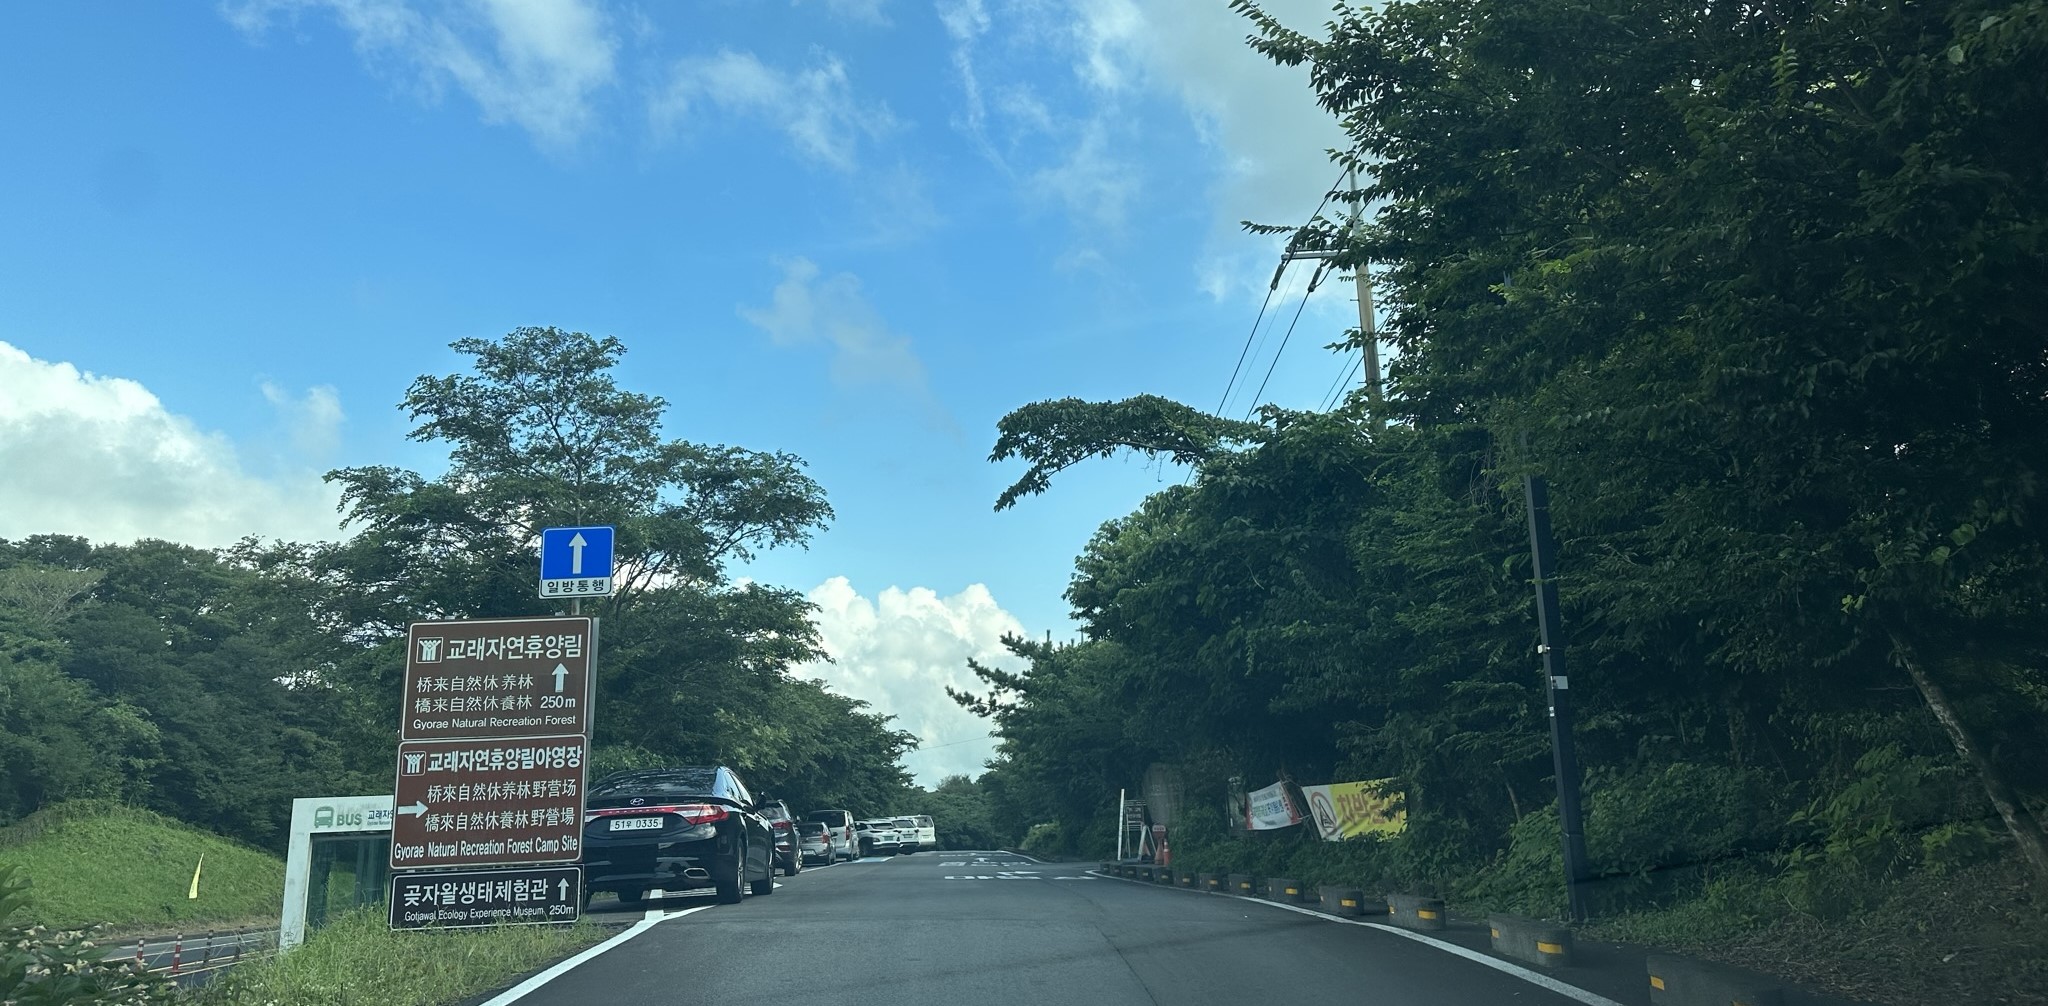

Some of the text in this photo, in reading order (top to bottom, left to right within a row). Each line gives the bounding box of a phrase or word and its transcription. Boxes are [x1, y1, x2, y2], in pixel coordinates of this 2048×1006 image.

[548, 580, 604, 593] 일방통행
[446, 634, 582, 661] 교래자연휴양림
[416, 673, 534, 693] 桥来自然休养林
[413, 715, 576, 731] Gyorae Natural Recreation Forest
[427, 745, 582, 773] 교래자연휴양림야영장
[337, 813, 362, 826] BUS
[614, 818, 659, 830] 51우 0335
[394, 835, 578, 860] Gyorae Natural Recreation Forest Camp Site
[403, 878, 549, 907] 곶자왈생태체험관
[404, 904, 574, 923] Gotjawal Ecology Experience Museum 250m
